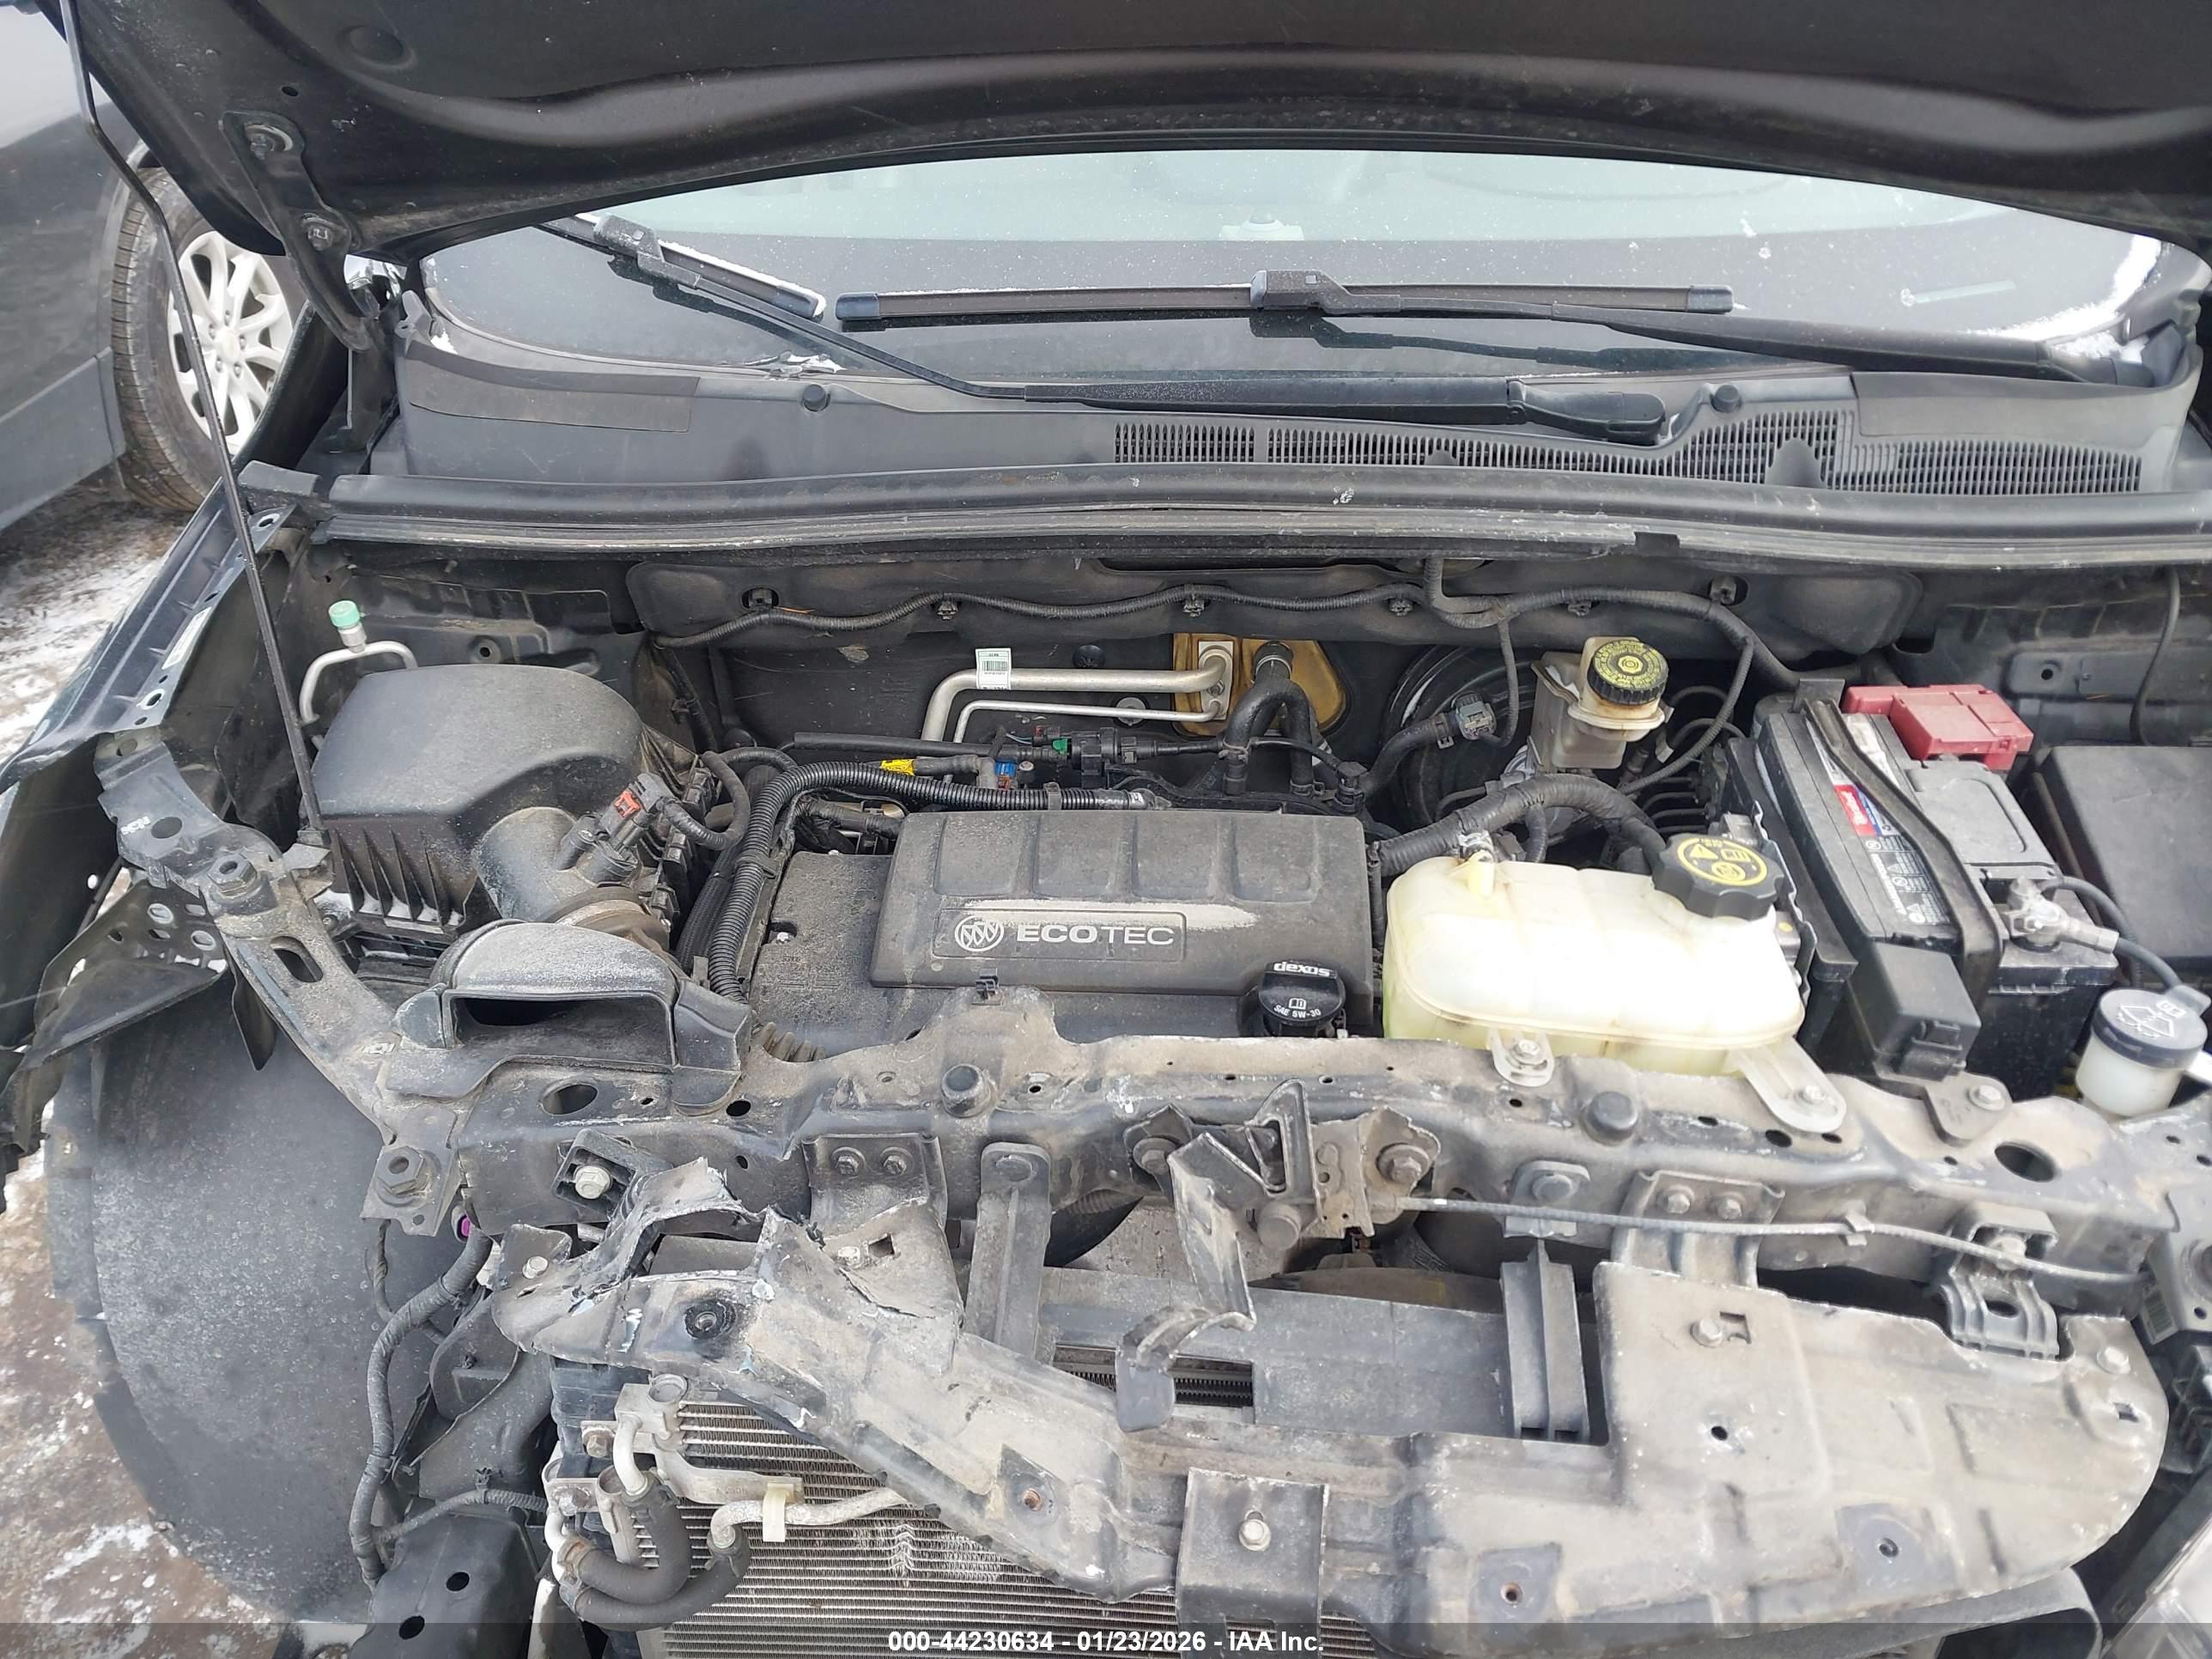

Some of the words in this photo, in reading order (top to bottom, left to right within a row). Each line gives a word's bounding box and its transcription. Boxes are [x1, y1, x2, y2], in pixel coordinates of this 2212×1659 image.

[1017, 924, 1175, 945] ECOTEC
[1273, 962, 1330, 976] dexos
[1273, 1005, 1290, 1017] SAE
[1291, 1008, 1322, 1018] 5W-30
